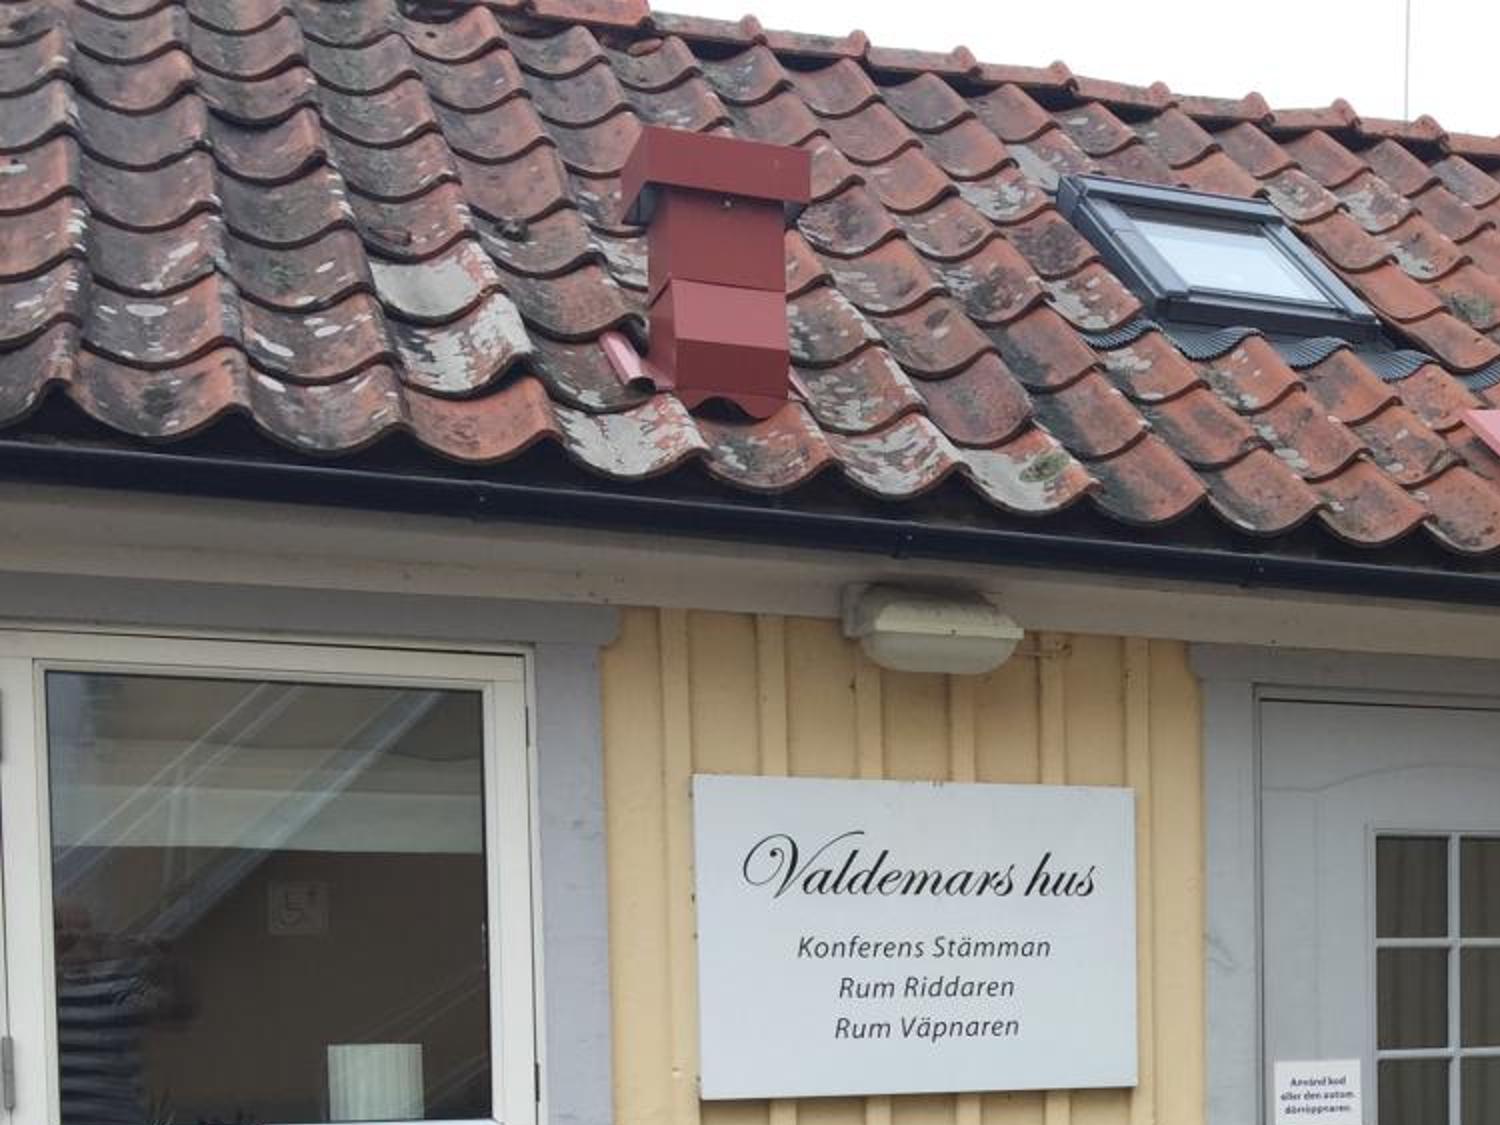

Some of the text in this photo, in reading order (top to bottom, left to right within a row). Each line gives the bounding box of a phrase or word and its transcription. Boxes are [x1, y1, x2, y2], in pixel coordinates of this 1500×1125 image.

[743, 830, 1096, 899] Valdemars hus
[797, 935, 1051, 959] Konferens Stämman
[838, 975, 1015, 999] Rum Riddaren
[834, 1015, 1020, 1044] Rum Väpnaren
[1303, 1090, 1322, 1100] den
